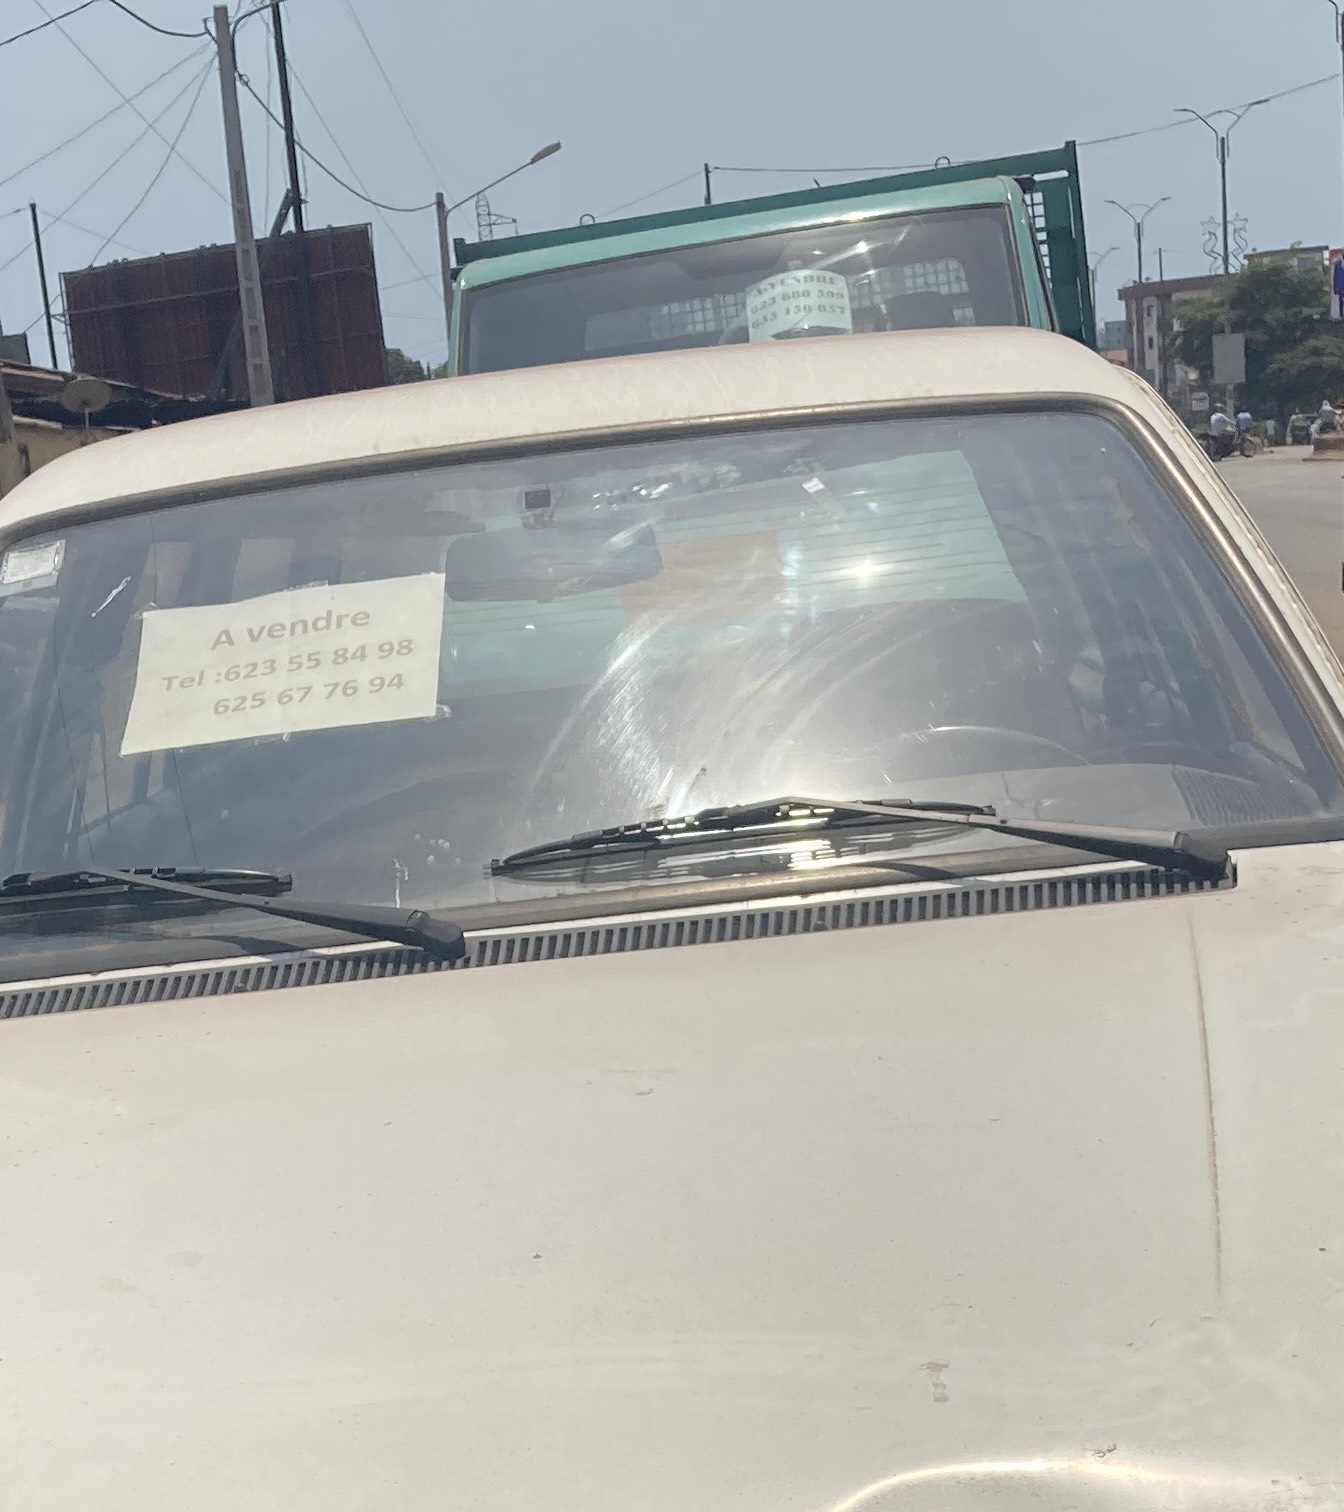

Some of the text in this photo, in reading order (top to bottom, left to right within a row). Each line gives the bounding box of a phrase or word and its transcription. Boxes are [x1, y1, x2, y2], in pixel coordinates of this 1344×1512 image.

[210, 610, 370, 651] A vendre
[161, 670, 205, 692] Tel
[286, 652, 321, 673] 55
[332, 644, 368, 665] 84
[378, 638, 414, 660] 98
[213, 673, 404, 715] 625 67 76 94
